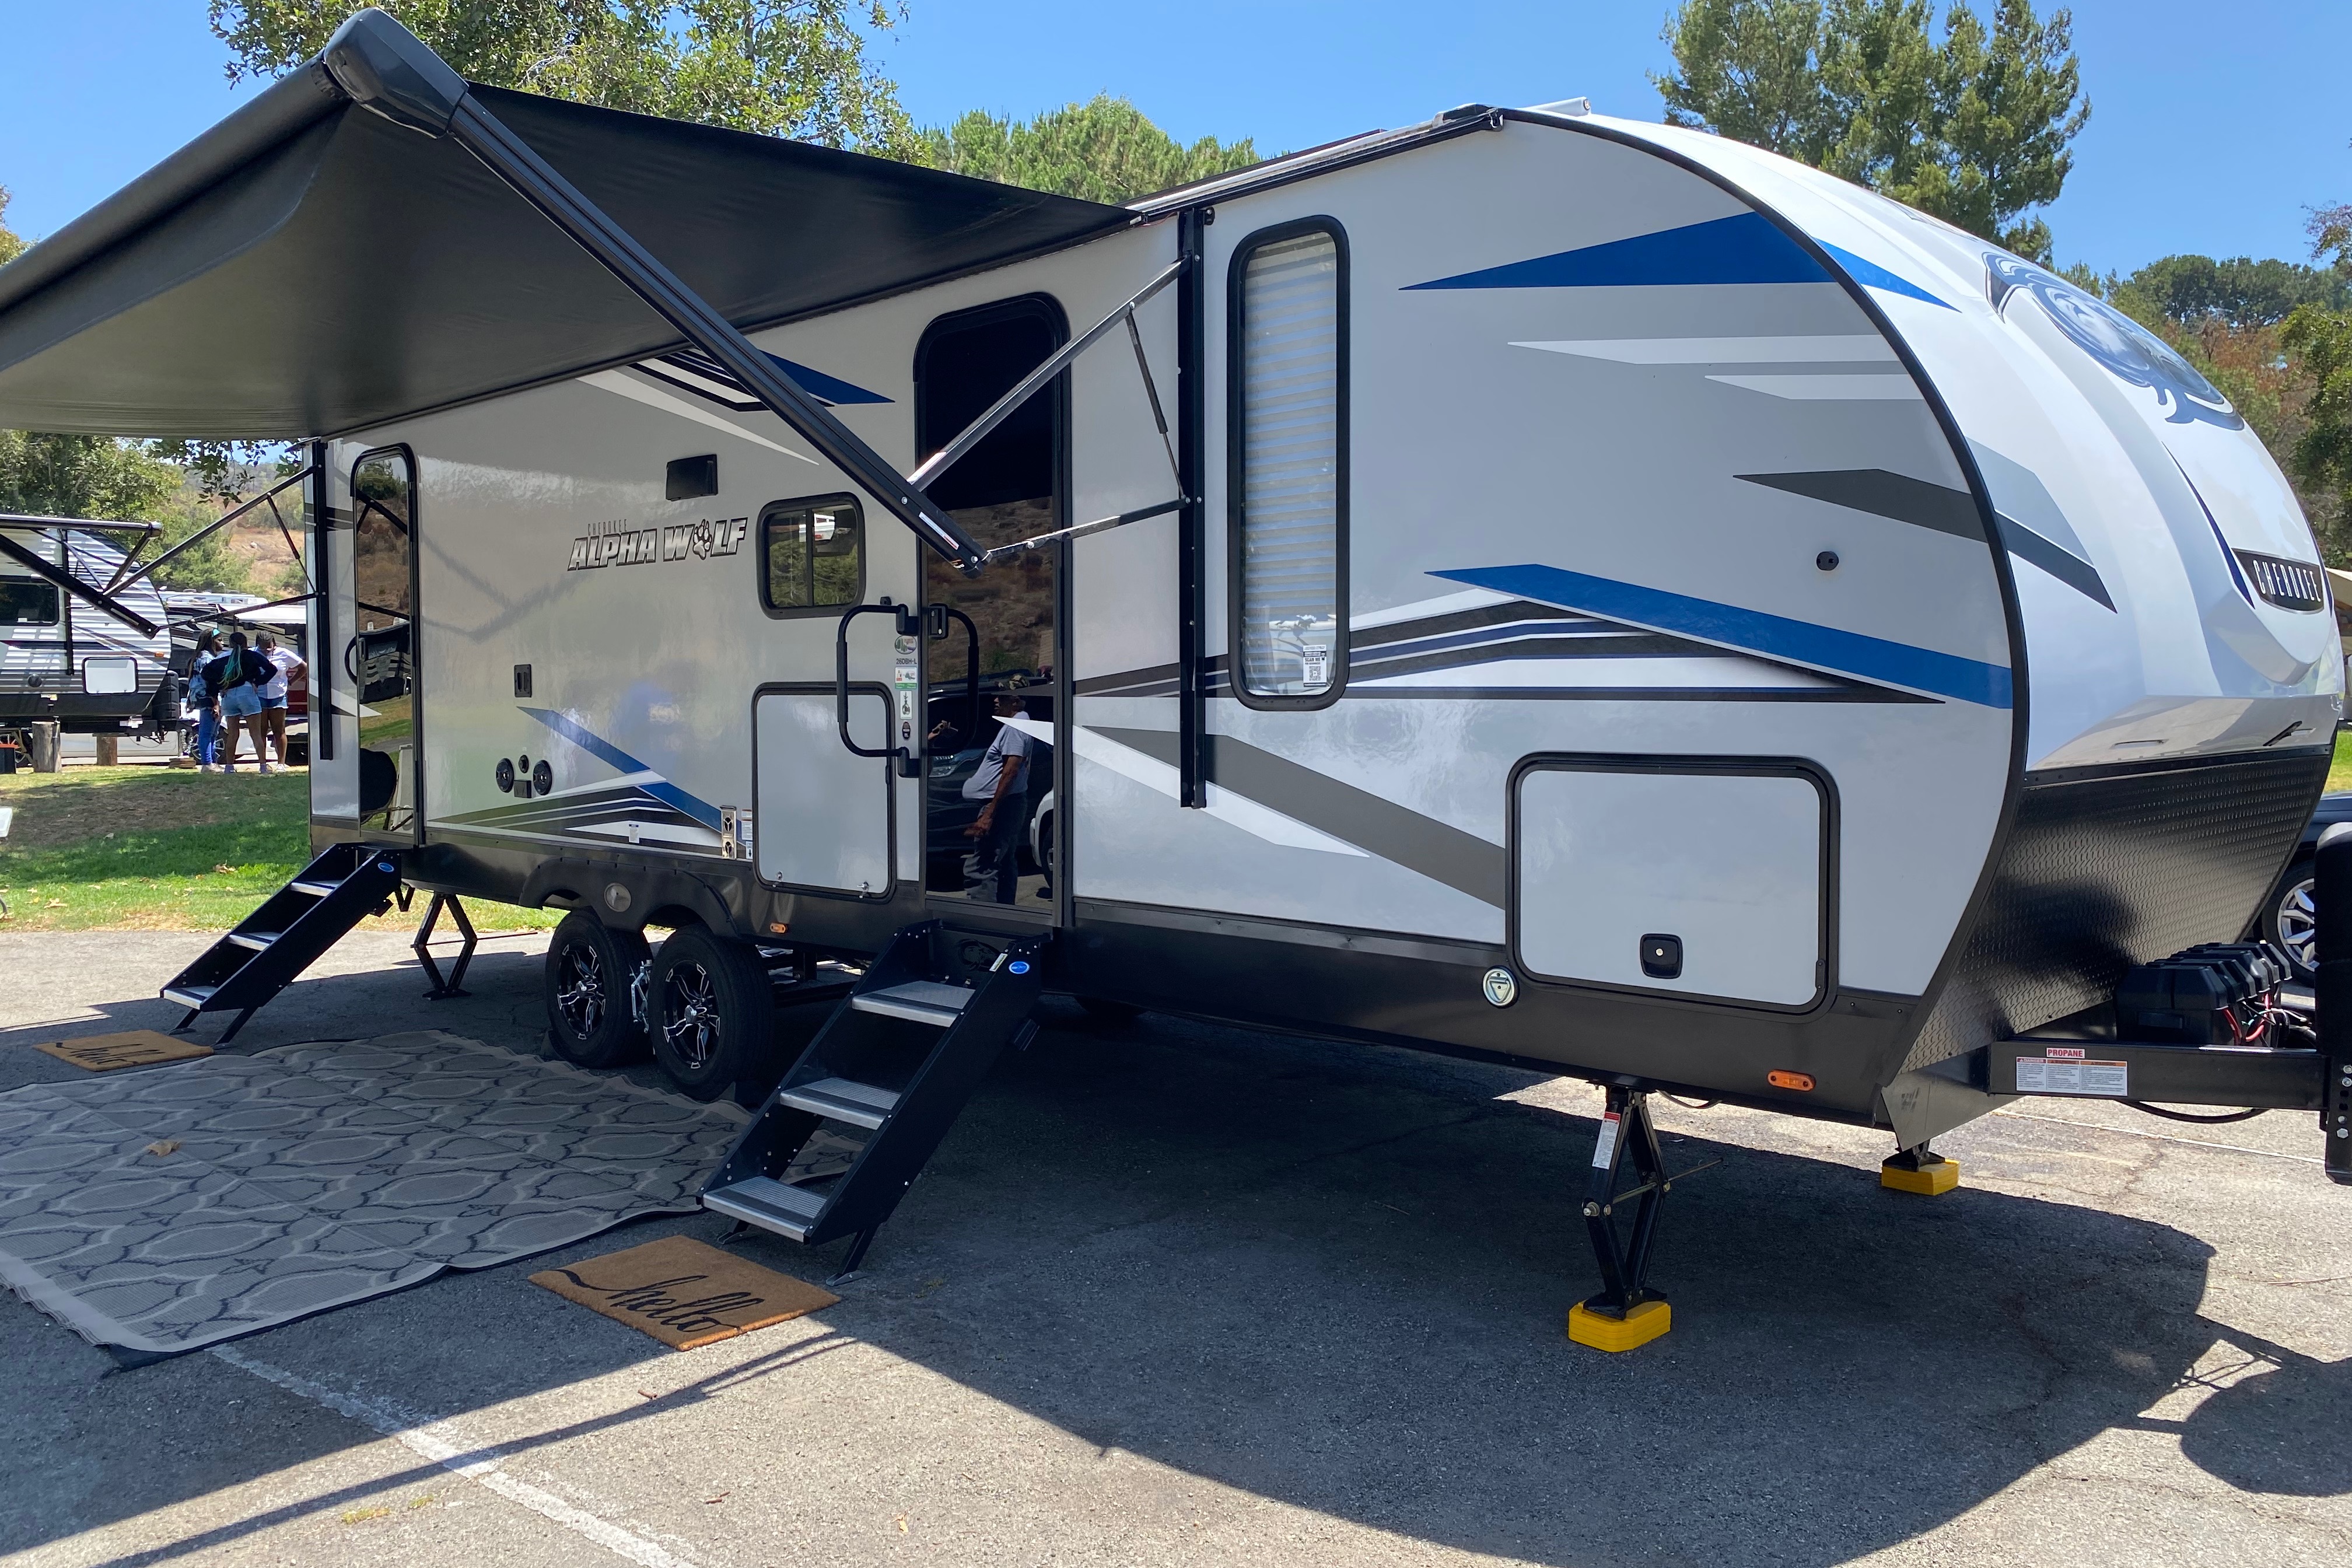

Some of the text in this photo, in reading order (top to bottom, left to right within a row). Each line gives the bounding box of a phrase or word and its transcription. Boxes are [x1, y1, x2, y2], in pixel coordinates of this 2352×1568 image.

[587, 519, 626, 536] CHEROKEE
[567, 528, 657, 571] ALPHA
[2253, 559, 2321, 602] CHEROKEE
[2048, 1049, 2083, 1057] PROPANE
